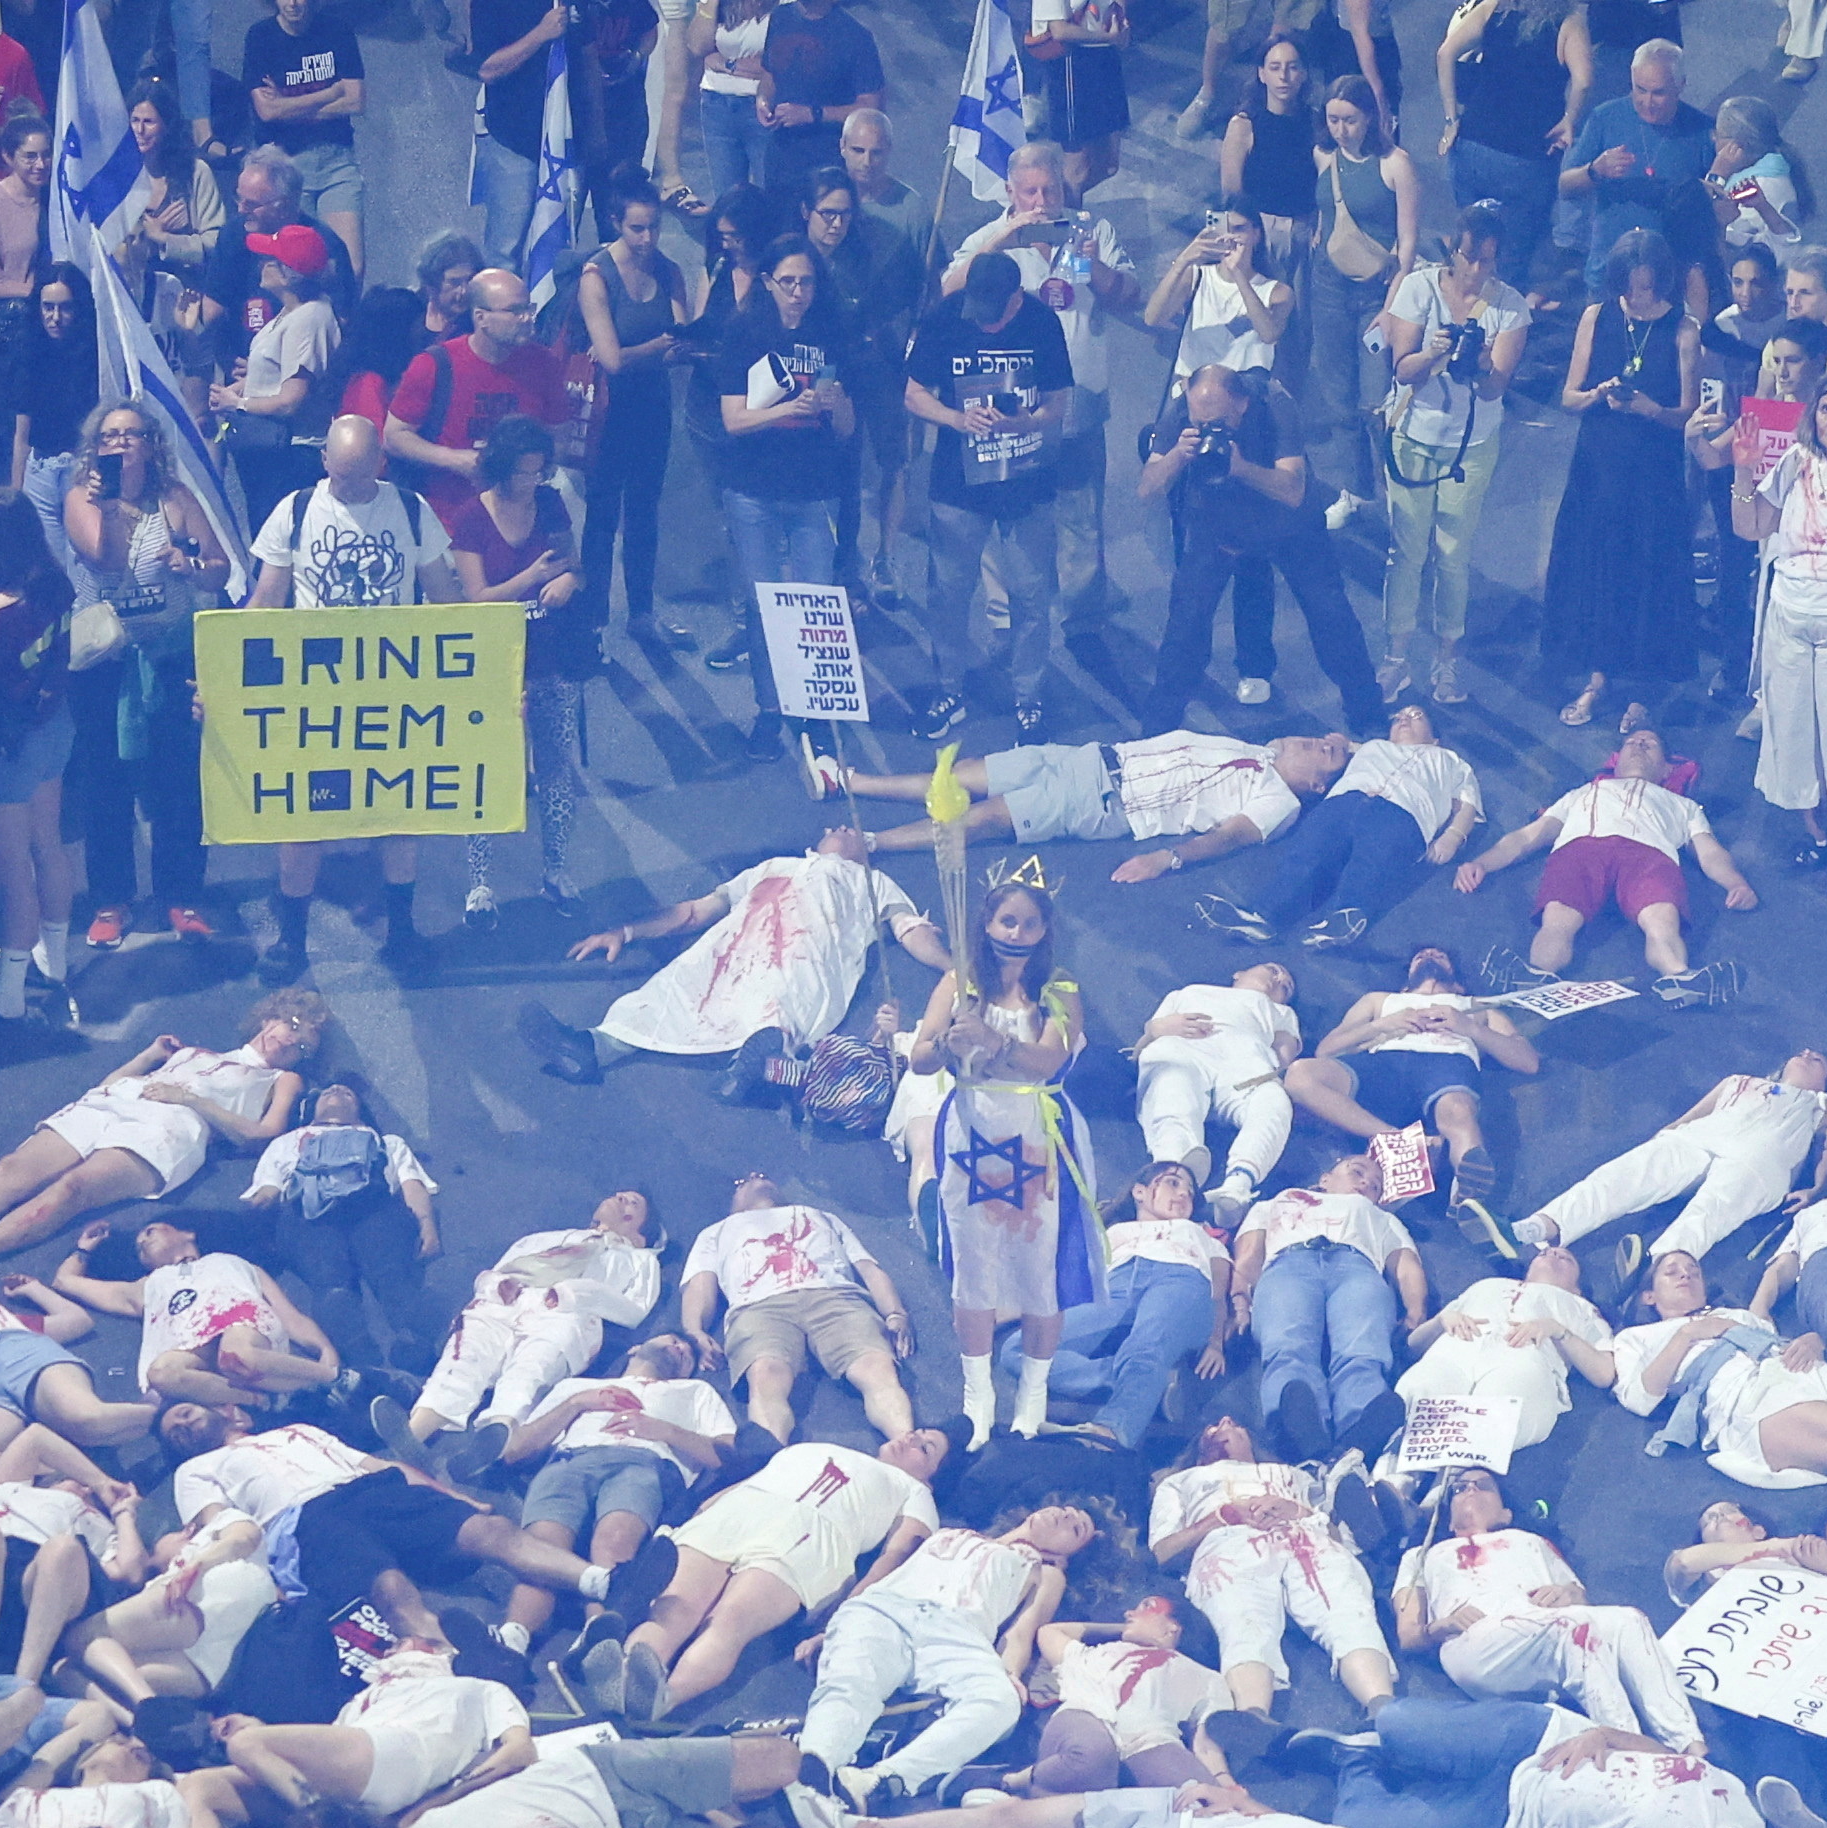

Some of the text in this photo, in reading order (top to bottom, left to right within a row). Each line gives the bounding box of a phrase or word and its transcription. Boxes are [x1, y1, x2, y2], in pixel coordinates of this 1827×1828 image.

[774, 592, 841, 609] האחיות
[804, 611, 843, 626] שלנו
[800, 627, 847, 643] מתות
[797, 643, 850, 660] שנציל
[242, 633, 475, 687] BRING
[811, 662, 853, 678] אותן.
[804, 679, 856, 695] עסקה
[806, 696, 859, 712] עכשיו.
[243, 704, 445, 750] THEM
[254, 763, 485, 819] HOME!
[1415, 1405, 1488, 1416] PEOPLE
[1417, 1398, 1457, 1407] OUR
[1411, 1421, 1469, 1429] DYING
[1413, 1413, 1450, 1421] ARE
[1409, 1428, 1465, 1436] TO BE
[1408, 1436, 1472, 1445] SAVED.
[1405, 1450, 1492, 1463] THE WAR.
[1406, 1444, 1450, 1454] STOP
[1746, 1622, 1813, 1678] שיחזרו
